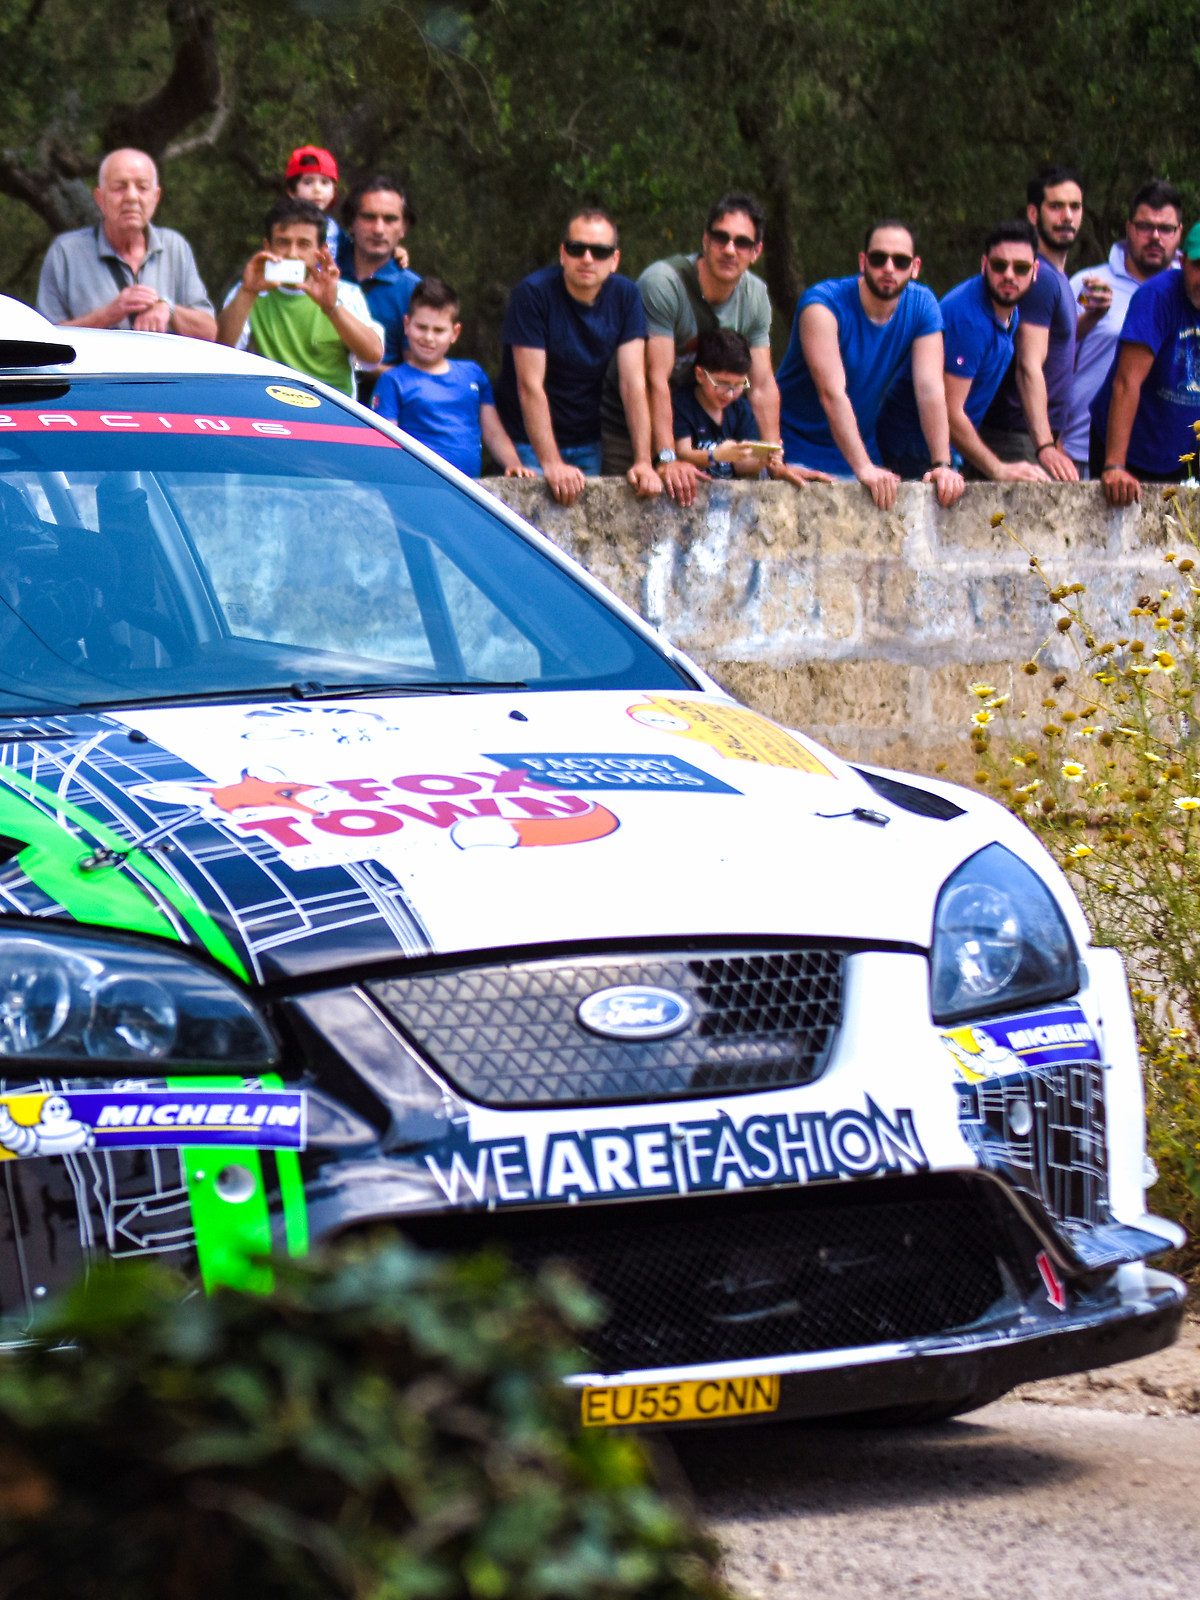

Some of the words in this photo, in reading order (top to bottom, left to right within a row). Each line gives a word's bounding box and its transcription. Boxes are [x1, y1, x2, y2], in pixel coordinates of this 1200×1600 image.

[524, 758, 684, 773] FACTORY
[545, 771, 706, 787] STORES
[326, 769, 567, 802] FOX
[236, 796, 592, 848] TOWN
[605, 996, 665, 1026] Ford
[1006, 1022, 1095, 1050] MICHELIN
[99, 1103, 300, 1127] MICHELIN
[425, 1144, 528, 1205] WE
[546, 1131, 673, 1197] ARE
[684, 1114, 928, 1184] FASHION
[587, 1385, 682, 1422] EU55
[695, 1376, 774, 1414] CNN
